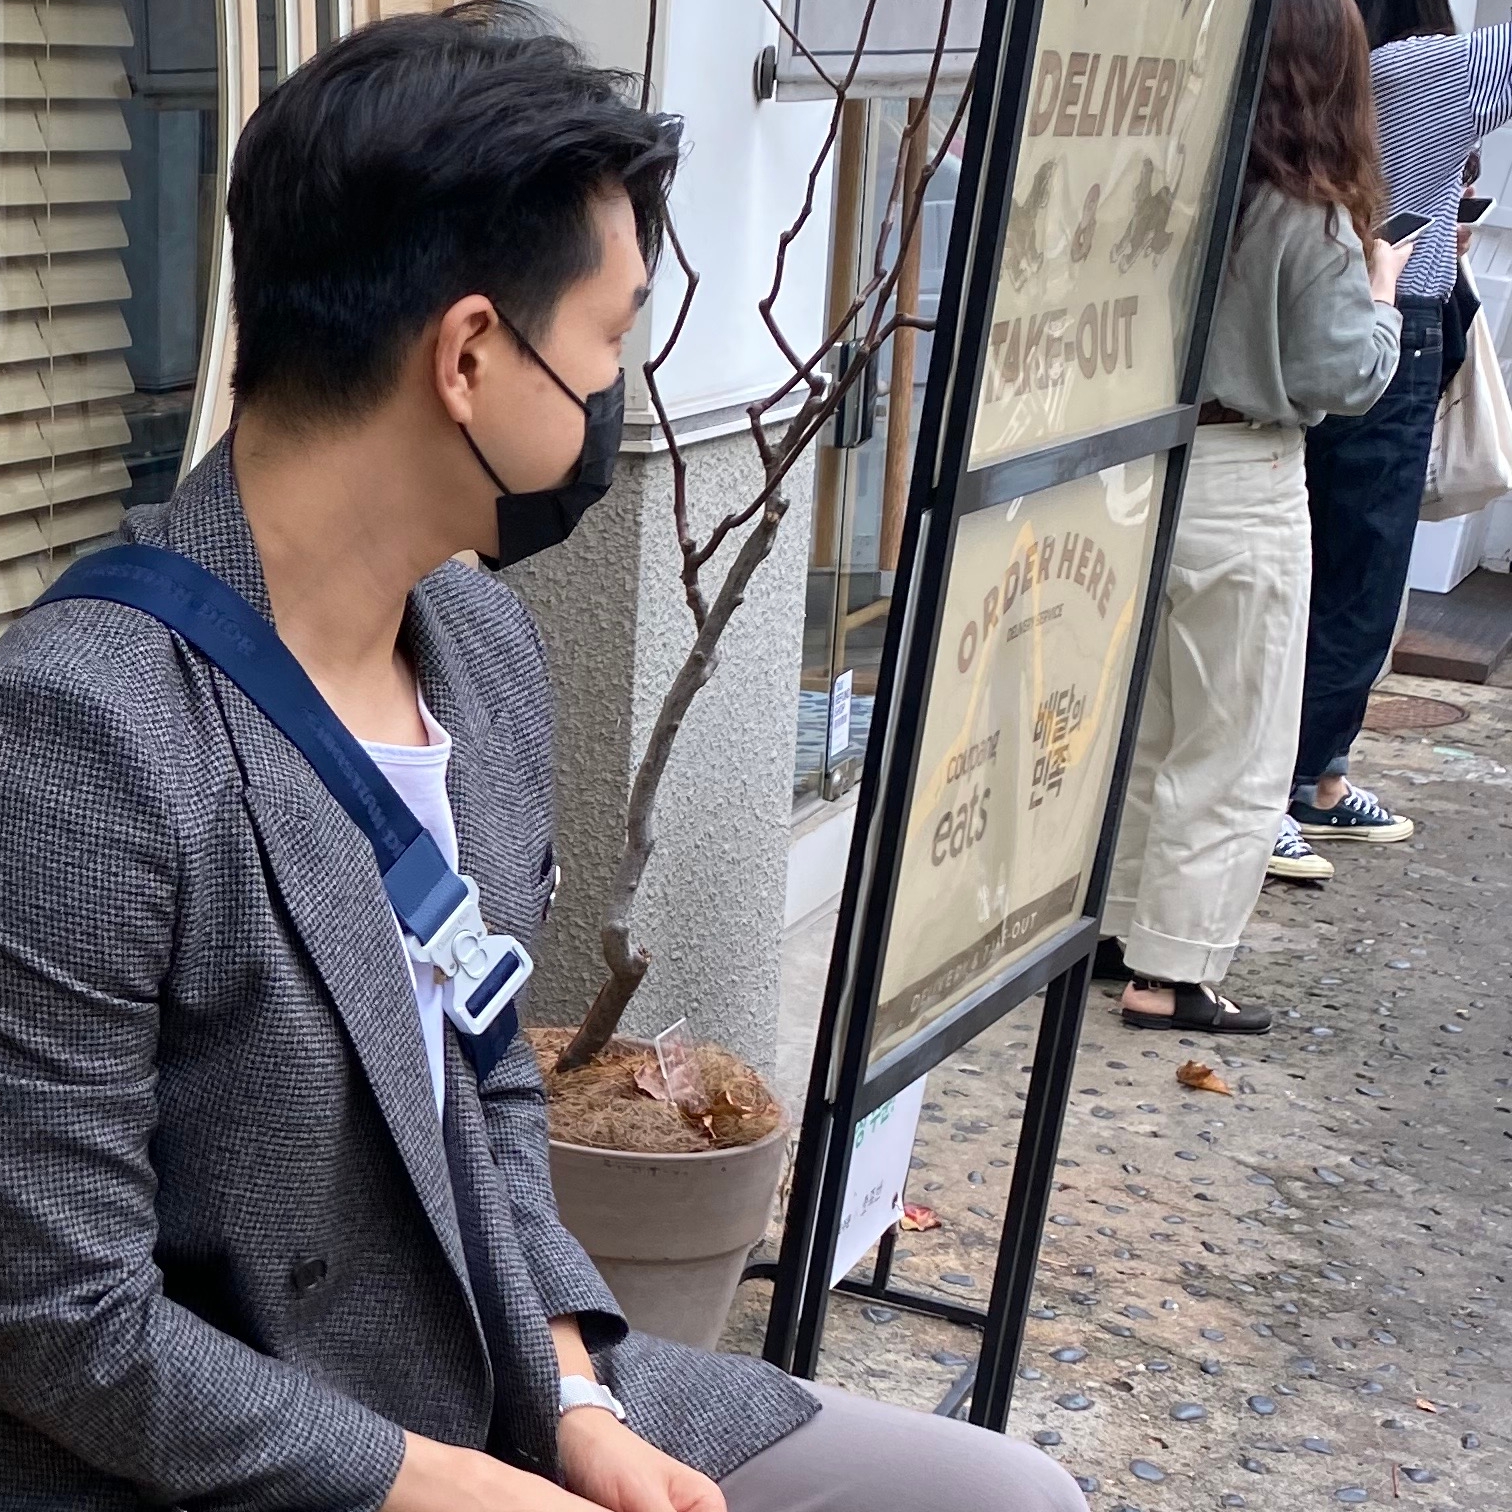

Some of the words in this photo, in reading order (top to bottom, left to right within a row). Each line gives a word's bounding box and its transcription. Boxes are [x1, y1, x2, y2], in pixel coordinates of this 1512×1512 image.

[986, 295, 1139, 404] TAKE-OUT
[957, 534, 1056, 674] ORDER
[1056, 531, 1117, 620] HERE
[931, 783, 991, 867] eats
